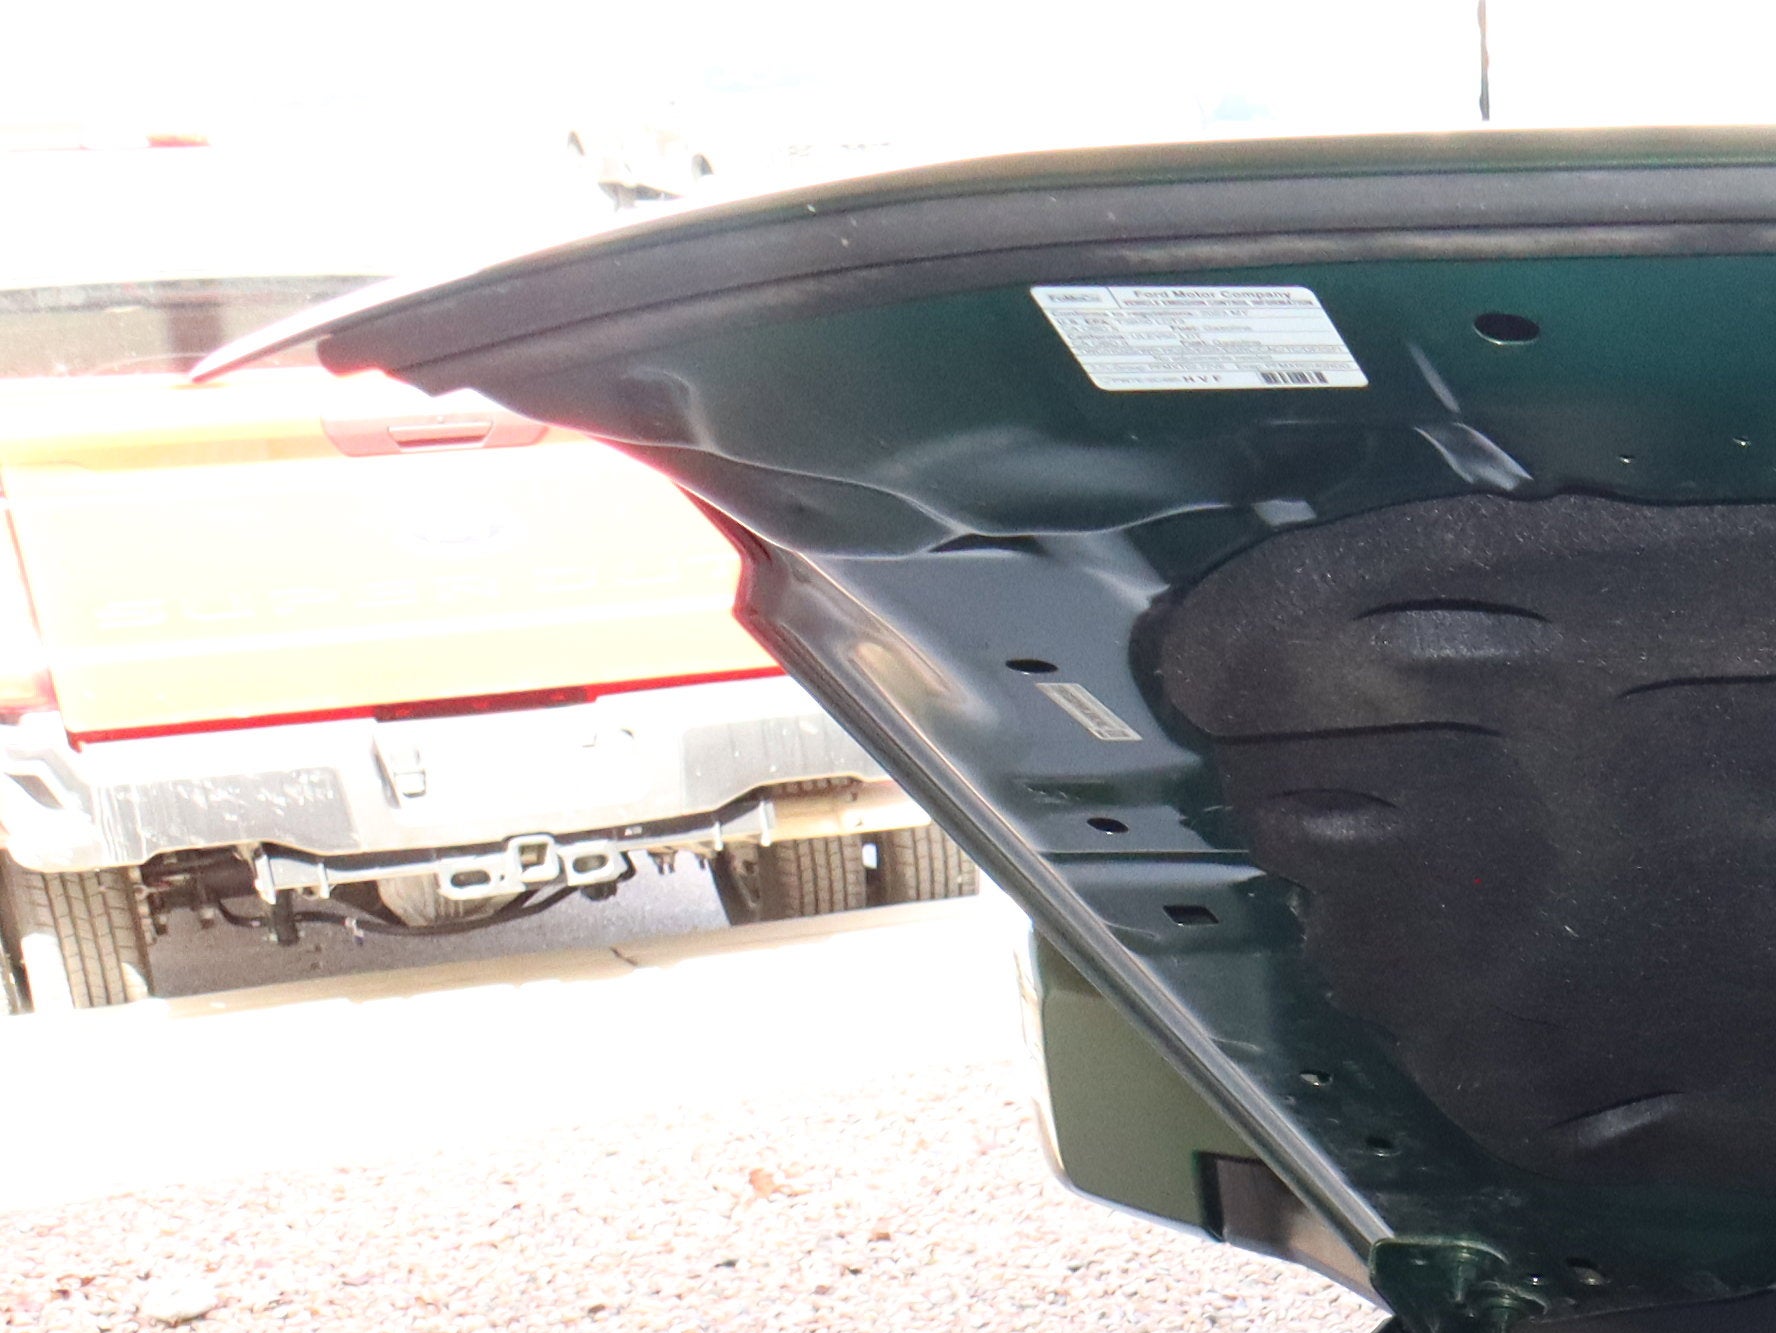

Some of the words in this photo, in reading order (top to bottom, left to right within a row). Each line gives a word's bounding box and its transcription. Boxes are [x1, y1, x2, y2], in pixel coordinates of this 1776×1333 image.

[1133, 290, 1169, 298] Ford
[1219, 290, 1292, 298] Company
[95, 573, 501, 630] SUPER
[532, 552, 740, 595] DUT
